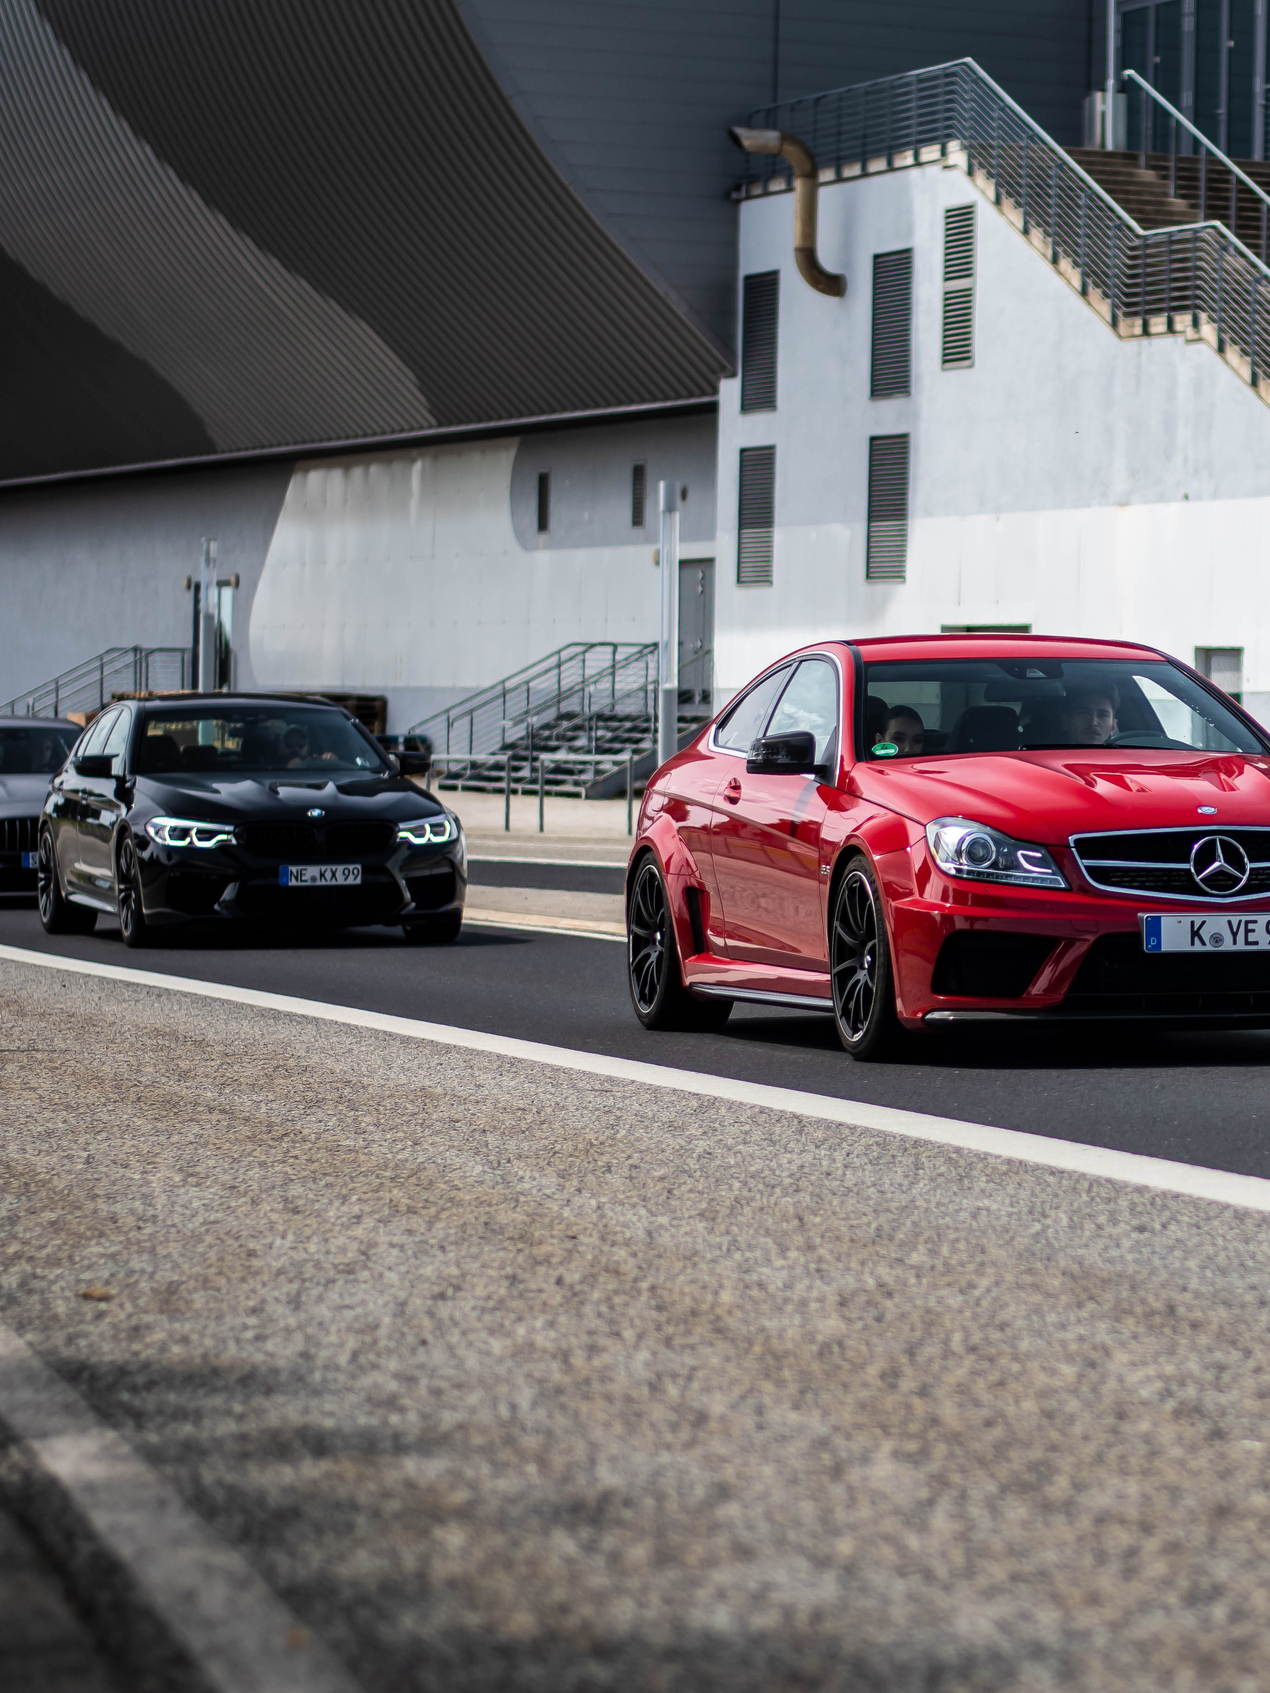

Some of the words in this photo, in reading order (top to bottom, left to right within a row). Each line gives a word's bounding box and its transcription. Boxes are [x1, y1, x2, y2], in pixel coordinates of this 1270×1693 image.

[289, 868, 309, 883] NE
[319, 867, 339, 883] KX
[342, 867, 360, 882] 99
[1150, 937, 1157, 945] D
[1190, 919, 1208, 947] K
[1227, 919, 1260, 946] YE
